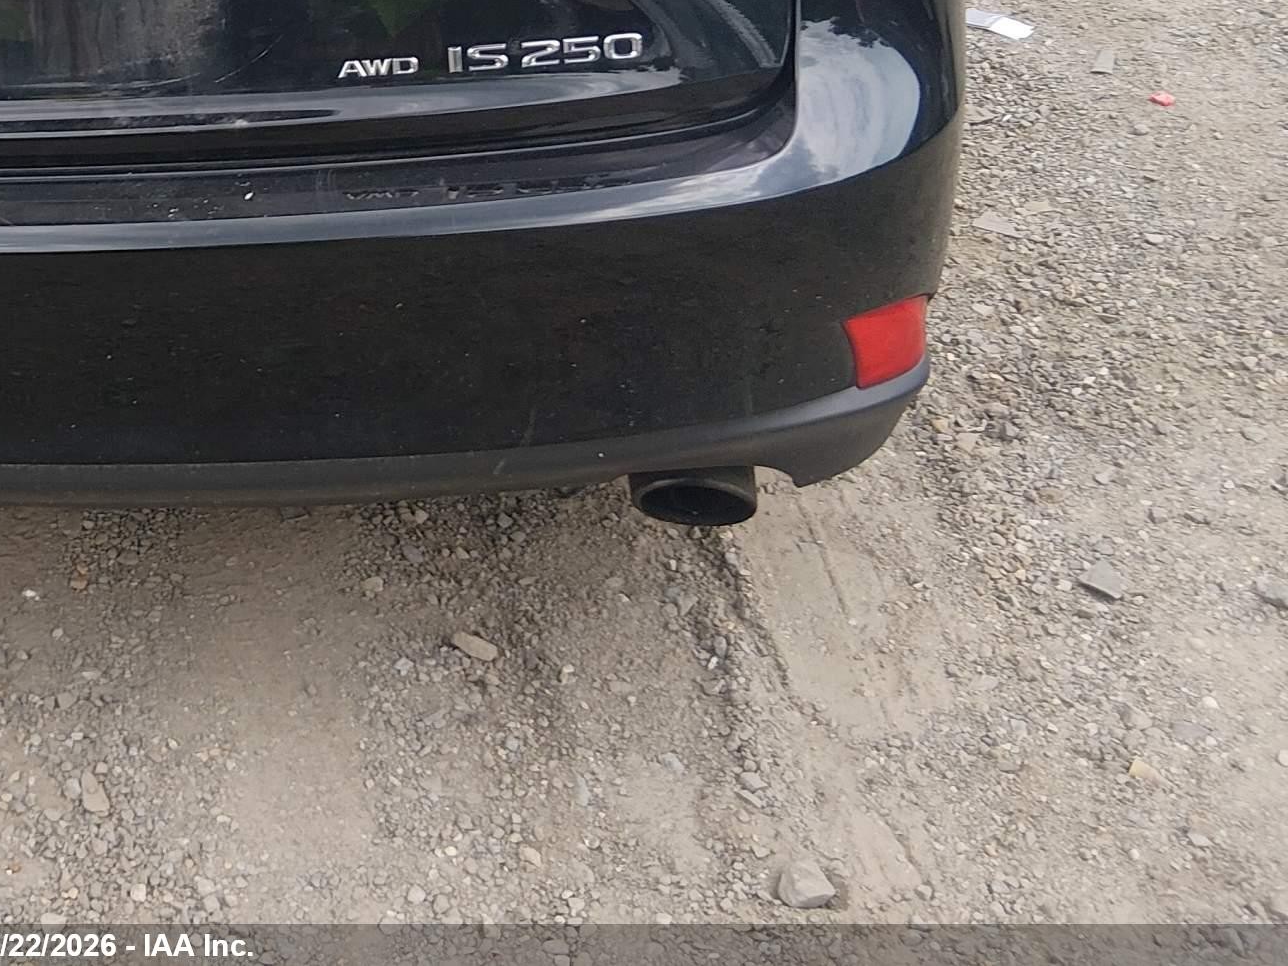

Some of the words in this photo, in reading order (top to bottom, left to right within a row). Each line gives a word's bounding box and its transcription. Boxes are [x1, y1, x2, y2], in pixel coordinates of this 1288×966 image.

[338, 56, 419, 79] AWD
[447, 42, 510, 74] IS
[520, 32, 643, 68] 250
